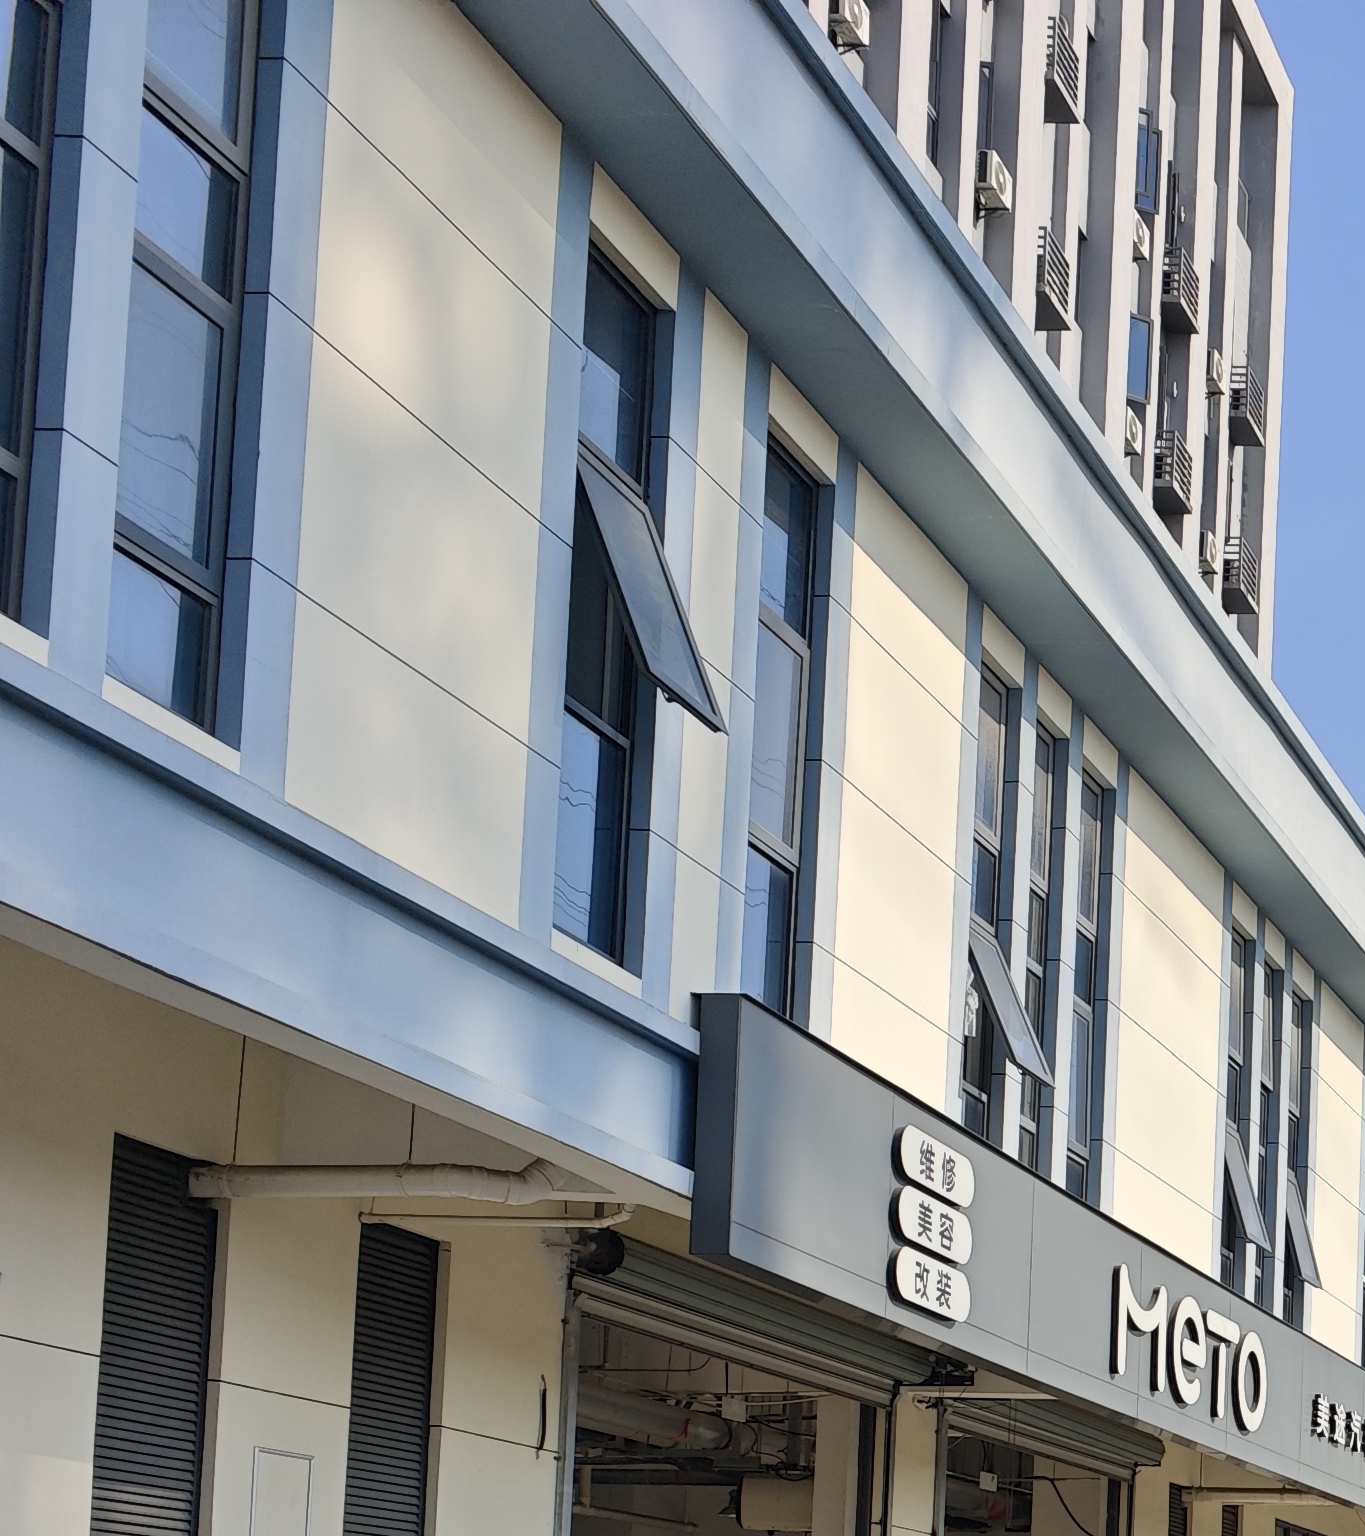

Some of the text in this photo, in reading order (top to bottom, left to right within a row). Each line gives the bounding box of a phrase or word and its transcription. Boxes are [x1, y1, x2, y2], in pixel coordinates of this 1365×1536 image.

[918, 1138, 958, 1194] 维修
[916, 1199, 956, 1252] 美容
[913, 1260, 953, 1312] 改装
